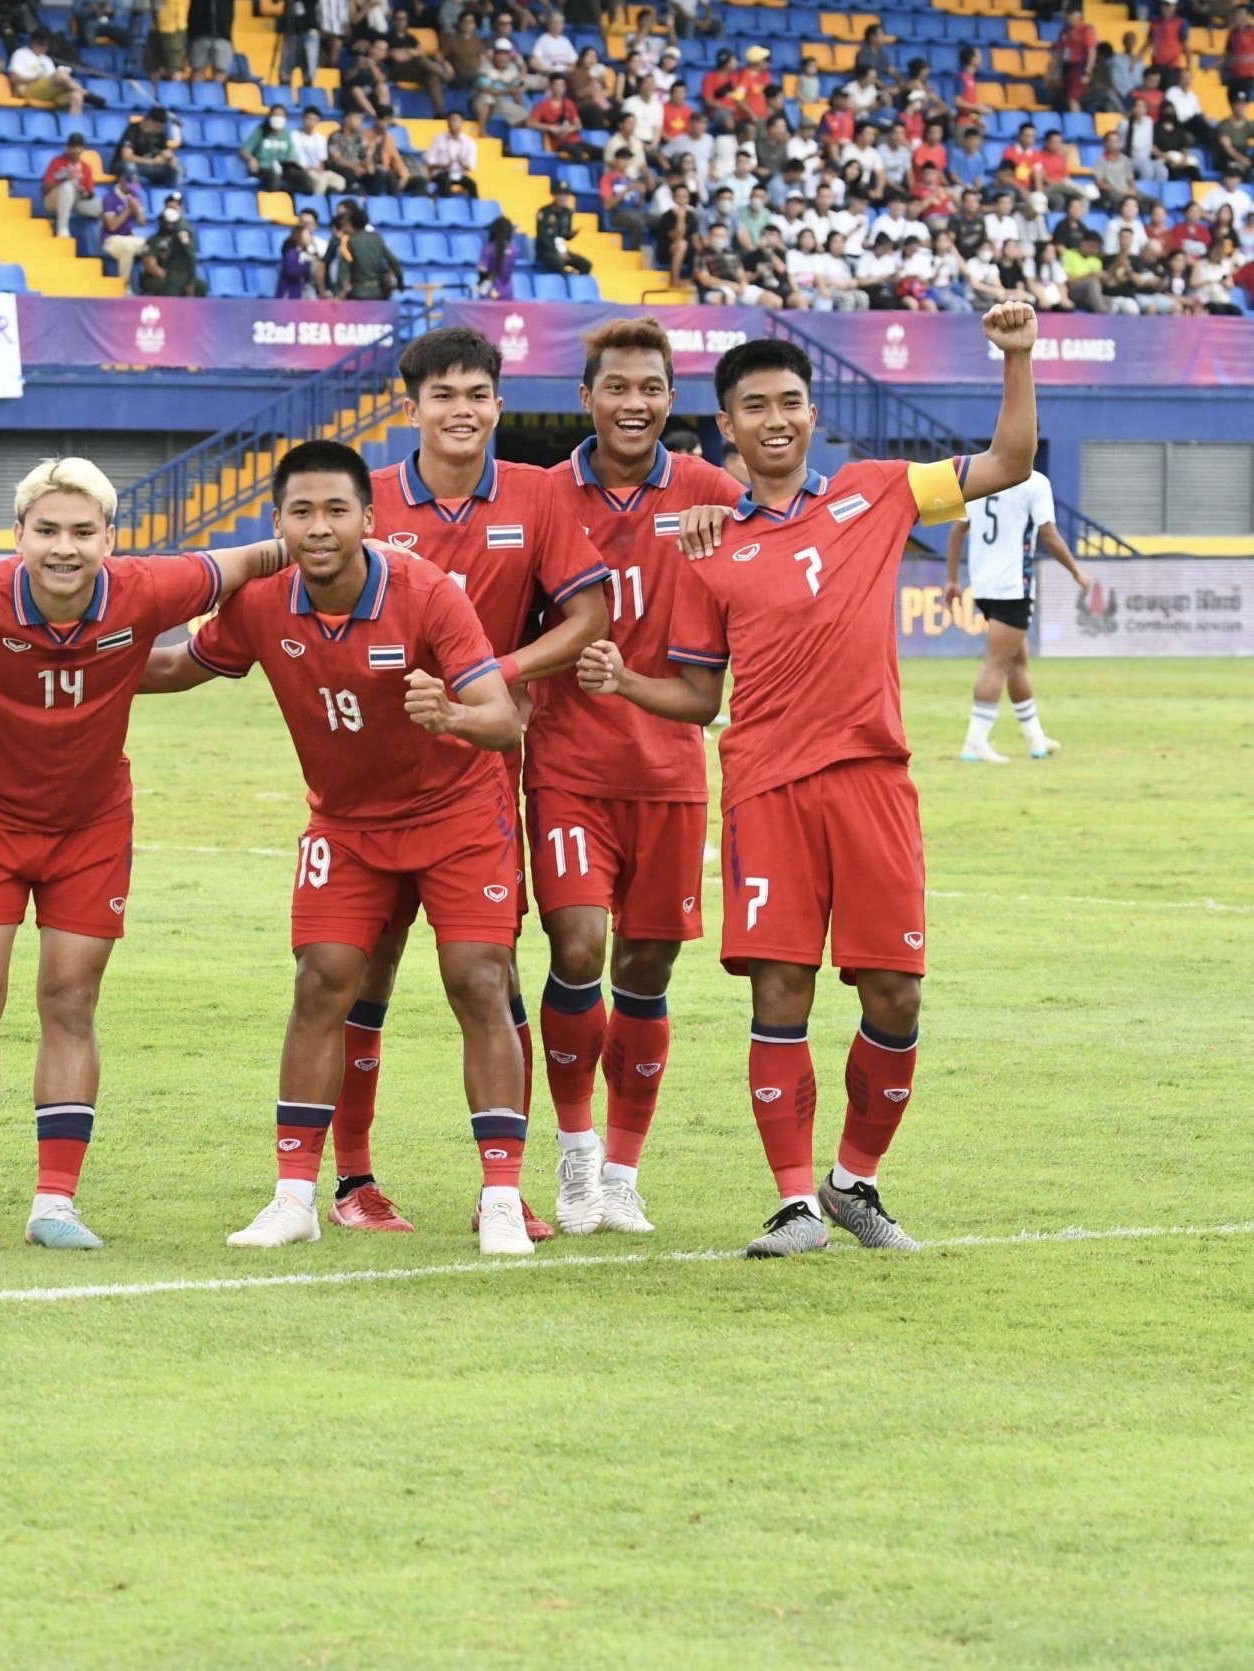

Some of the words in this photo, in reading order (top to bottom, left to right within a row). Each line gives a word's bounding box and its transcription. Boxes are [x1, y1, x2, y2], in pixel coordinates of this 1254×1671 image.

[252, 320, 295, 344] 32nd
[297, 321, 332, 346] SEA
[333, 322, 394, 347] GAMES
[1060, 338, 1116, 361] GAMES
[983, 495, 999, 545] 5
[607, 565, 644, 623] 11
[793, 545, 822, 597] 7
[38, 669, 84, 709] 14
[318, 687, 364, 732] 19
[297, 836, 331, 889] 19
[548, 826, 589, 878] 11
[744, 876, 769, 931] 7
